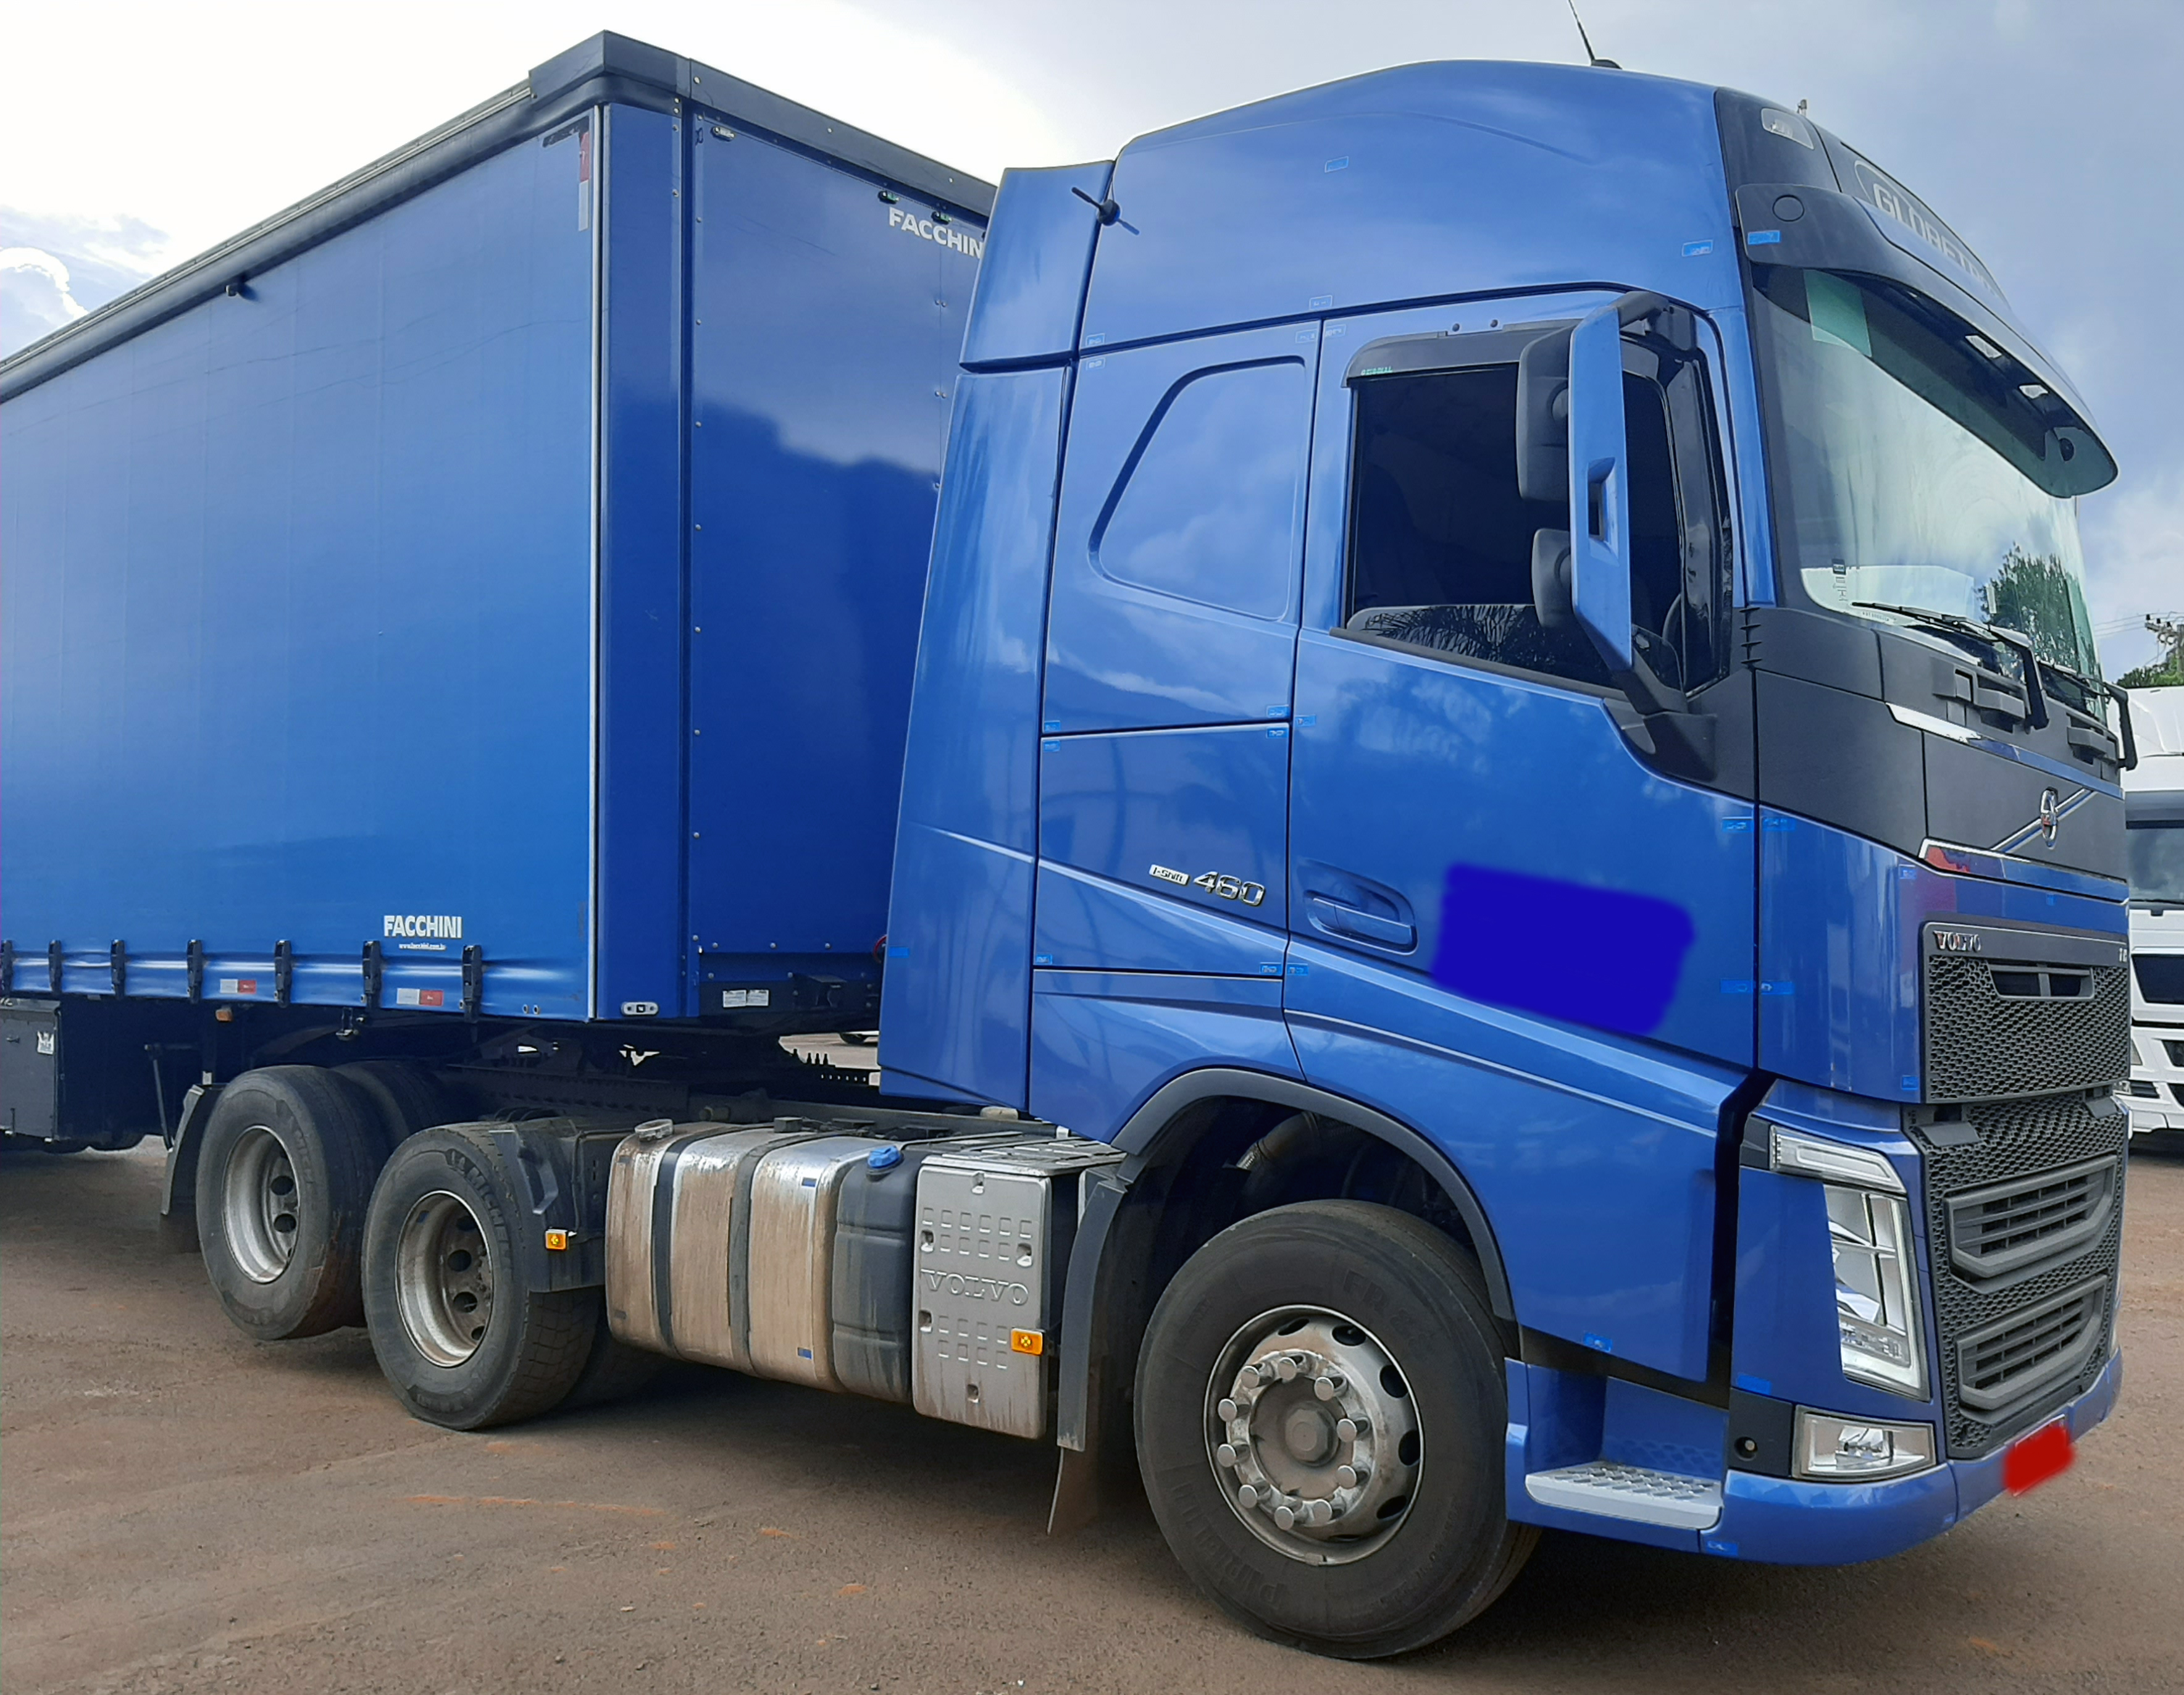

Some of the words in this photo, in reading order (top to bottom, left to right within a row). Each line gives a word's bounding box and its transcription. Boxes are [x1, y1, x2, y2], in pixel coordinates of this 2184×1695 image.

[1153, 867, 1183, 882] I-Shift
[1193, 871, 1266, 906] 460
[383, 915, 462, 939] FACCHINI
[1933, 931, 1981, 952] VOLVO
[921, 1268, 1029, 1306] VOLVO
